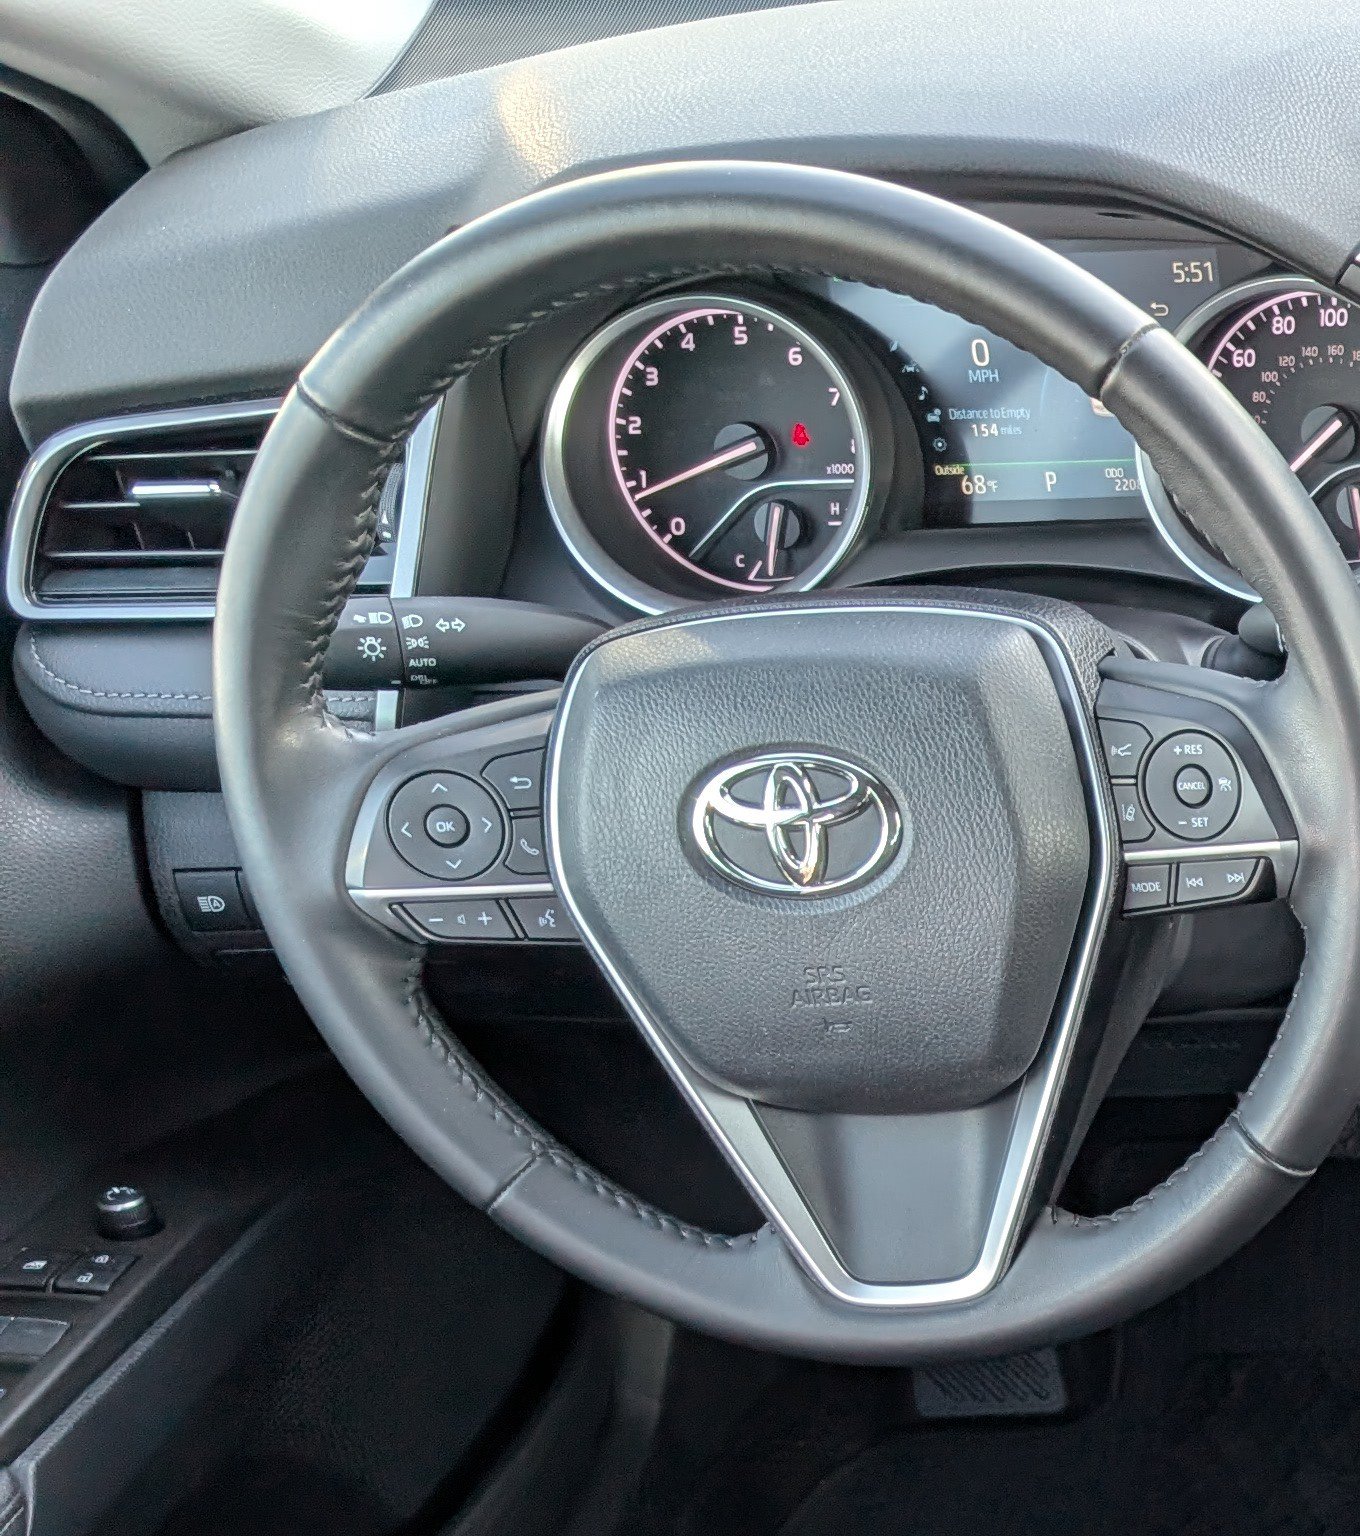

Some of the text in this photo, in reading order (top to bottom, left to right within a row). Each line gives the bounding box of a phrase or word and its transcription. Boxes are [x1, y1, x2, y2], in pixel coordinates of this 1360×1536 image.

[1172, 261, 1214, 284] 5:51
[1319, 308, 1348, 327] 100
[1271, 316, 1295, 335] 80
[681, 333, 696, 351] 4
[733, 326, 748, 345] 5
[788, 348, 802, 366] 6
[971, 338, 990, 367] 0
[1301, 345, 1319, 358] 140
[1327, 344, 1344, 356] 160
[1232, 349, 1256, 368] 60
[1278, 355, 1295, 368] 120
[645, 367, 659, 386] 3
[968, 369, 1000, 383] MPH
[1260, 371, 1279, 383] 100
[828, 387, 840, 406] 7
[1252, 391, 1266, 403] 80
[948, 407, 1031, 421] Distance to Empty
[628, 416, 642, 435] 2
[971, 424, 1022, 437] 154 miles
[826, 463, 855, 475] x1000
[934, 465, 965, 476] Outside
[1105, 467, 1124, 478] ODO
[639, 470, 647, 488] 1
[1044, 471, 1057, 492] P
[830, 502, 840, 515] H
[670, 517, 685, 536] 0
[735, 554, 745, 568] C
[408, 657, 437, 667] AUTO
[1184, 744, 1203, 755] RES
[1178, 782, 1205, 791] CANCEL
[436, 820, 455, 834] OK
[1191, 817, 1209, 828] SET
[1132, 882, 1161, 892] MODE
